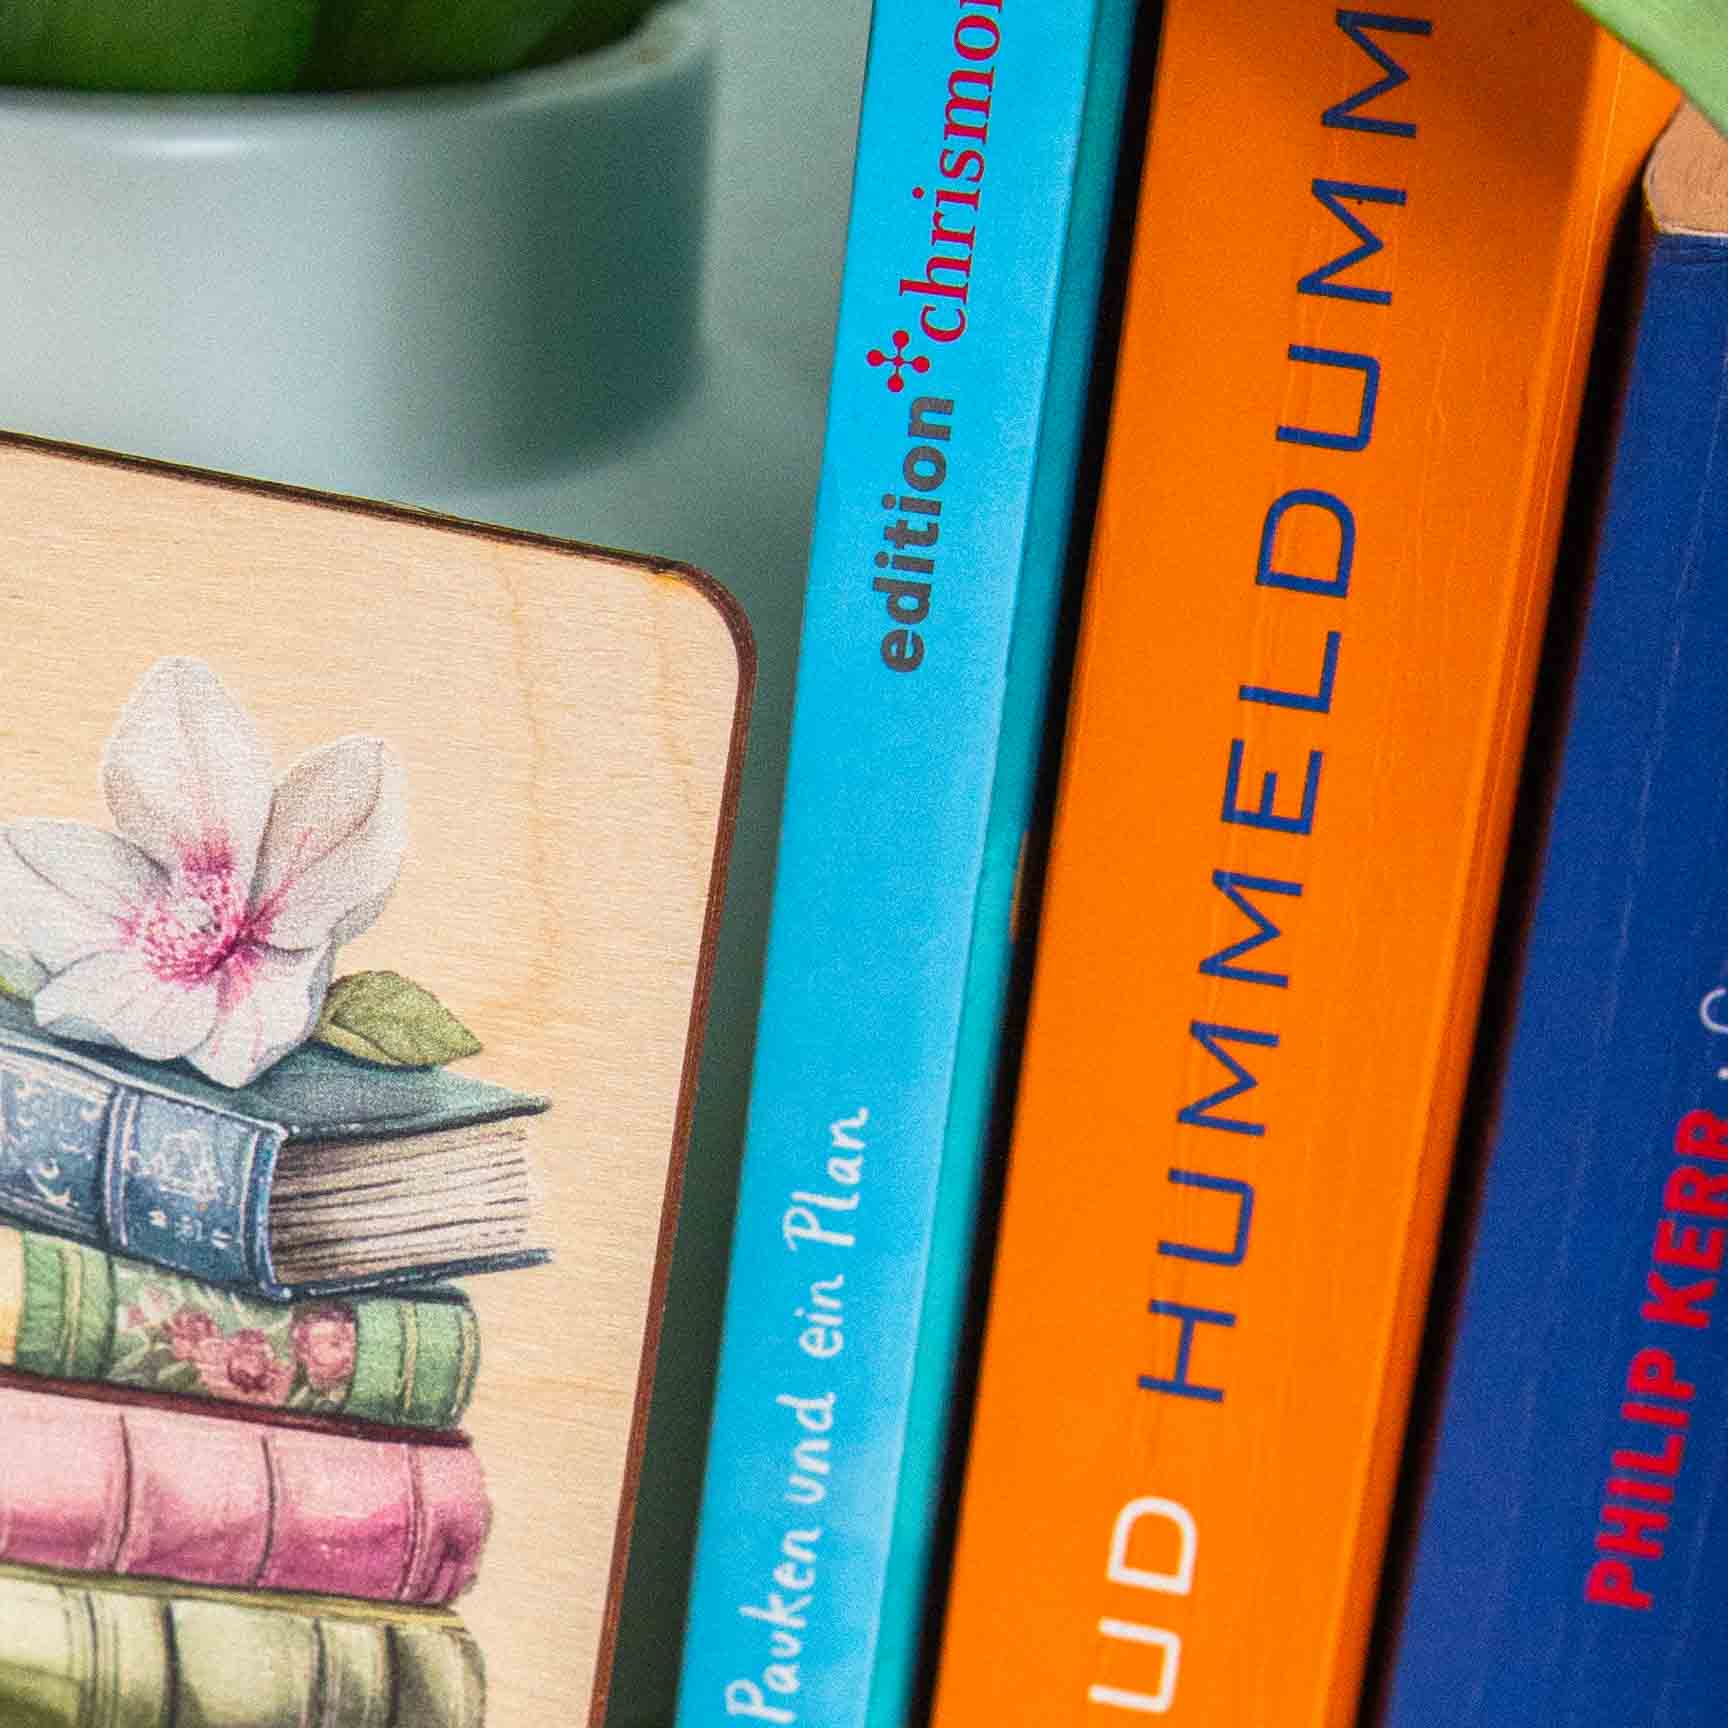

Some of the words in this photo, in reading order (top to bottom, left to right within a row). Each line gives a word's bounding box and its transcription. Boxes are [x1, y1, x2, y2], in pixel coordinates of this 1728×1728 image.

[900, 0, 1003, 342] chrismo
[872, 396, 955, 674] edition
[1137, 9, 1433, 1402] HUMMELDUMM
[783, 1106, 869, 1251] Plan
[1640, 1108, 1728, 1330] KERR
[798, 1274, 845, 1360] ein
[775, 1390, 837, 1507] und
[1586, 1347, 1695, 1610] PHILIP
[724, 1526, 822, 1725] Pauken
